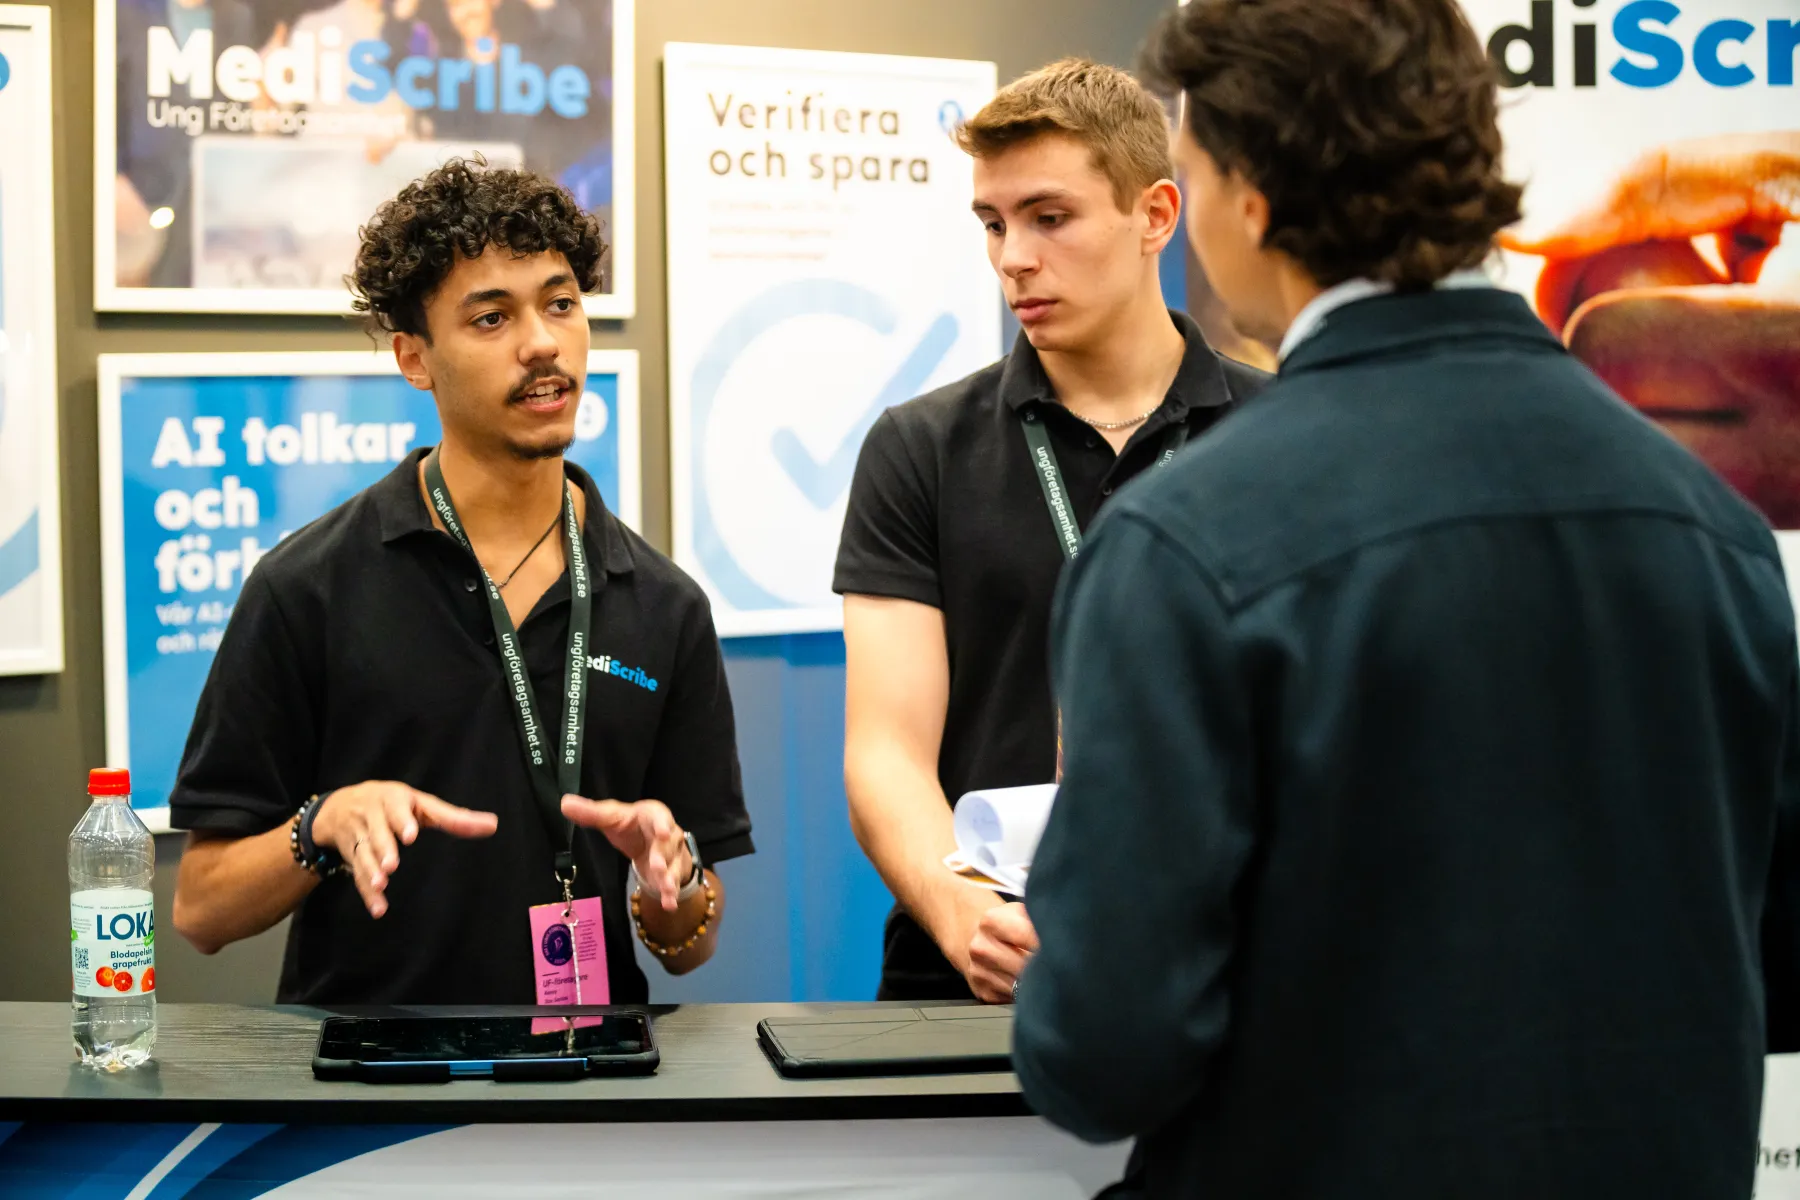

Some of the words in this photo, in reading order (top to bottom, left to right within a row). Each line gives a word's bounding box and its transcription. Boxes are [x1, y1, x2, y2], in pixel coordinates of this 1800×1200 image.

[1486, 0, 1800, 88] diScr
[146, 26, 591, 119] MediScribe
[147, 100, 204, 136] Ung
[708, 91, 900, 136] Verifiera
[709, 141, 787, 177] och
[809, 153, 931, 191] spara
[152, 416, 227, 468] AI
[242, 412, 416, 465] tolkar
[154, 475, 260, 530] och
[1036, 446, 1080, 560] ungföretagsamhet.se
[502, 633, 543, 765] ungföretagsamhet.se
[565, 632, 584, 764] ungföretagsamhet.se
[96, 909, 154, 941] LOKA
[110, 947, 153, 959] Blodapelsin
[112, 957, 152, 970] grapefrukt
